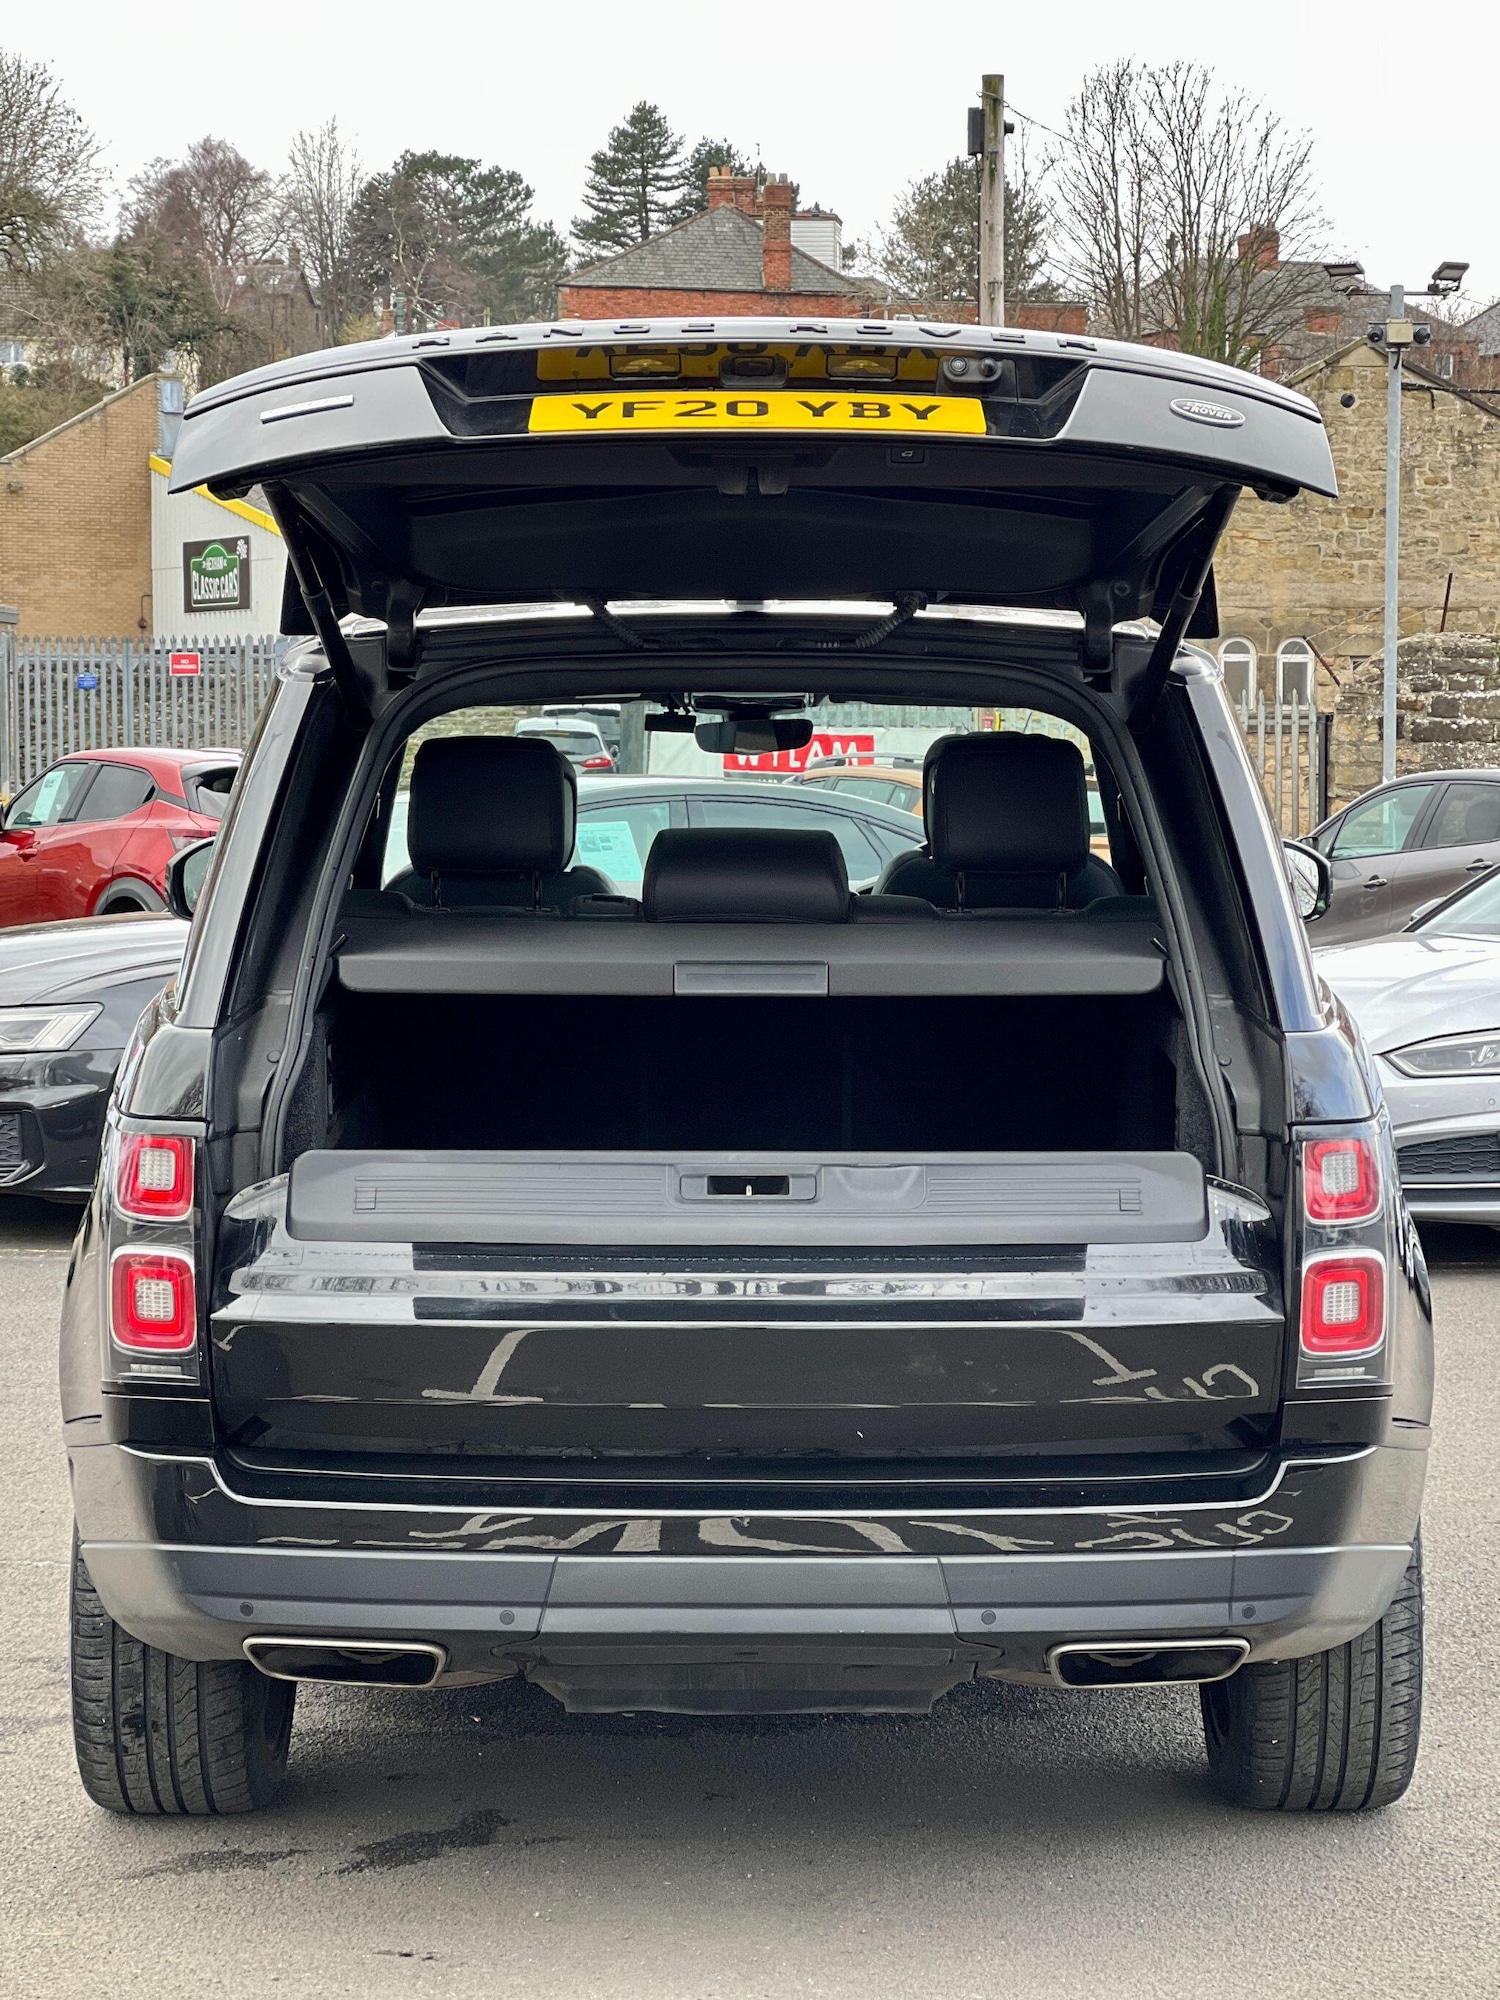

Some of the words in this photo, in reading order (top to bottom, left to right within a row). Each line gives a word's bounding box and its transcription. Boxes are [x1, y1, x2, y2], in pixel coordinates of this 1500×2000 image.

[412, 322, 715, 350] RANGE
[788, 322, 1098, 351] ROVER
[572, 400, 769, 419] YF20
[797, 400, 942, 420] YBY
[193, 570, 220, 600] CLASSIC
[220, 567, 238, 598] CARS
